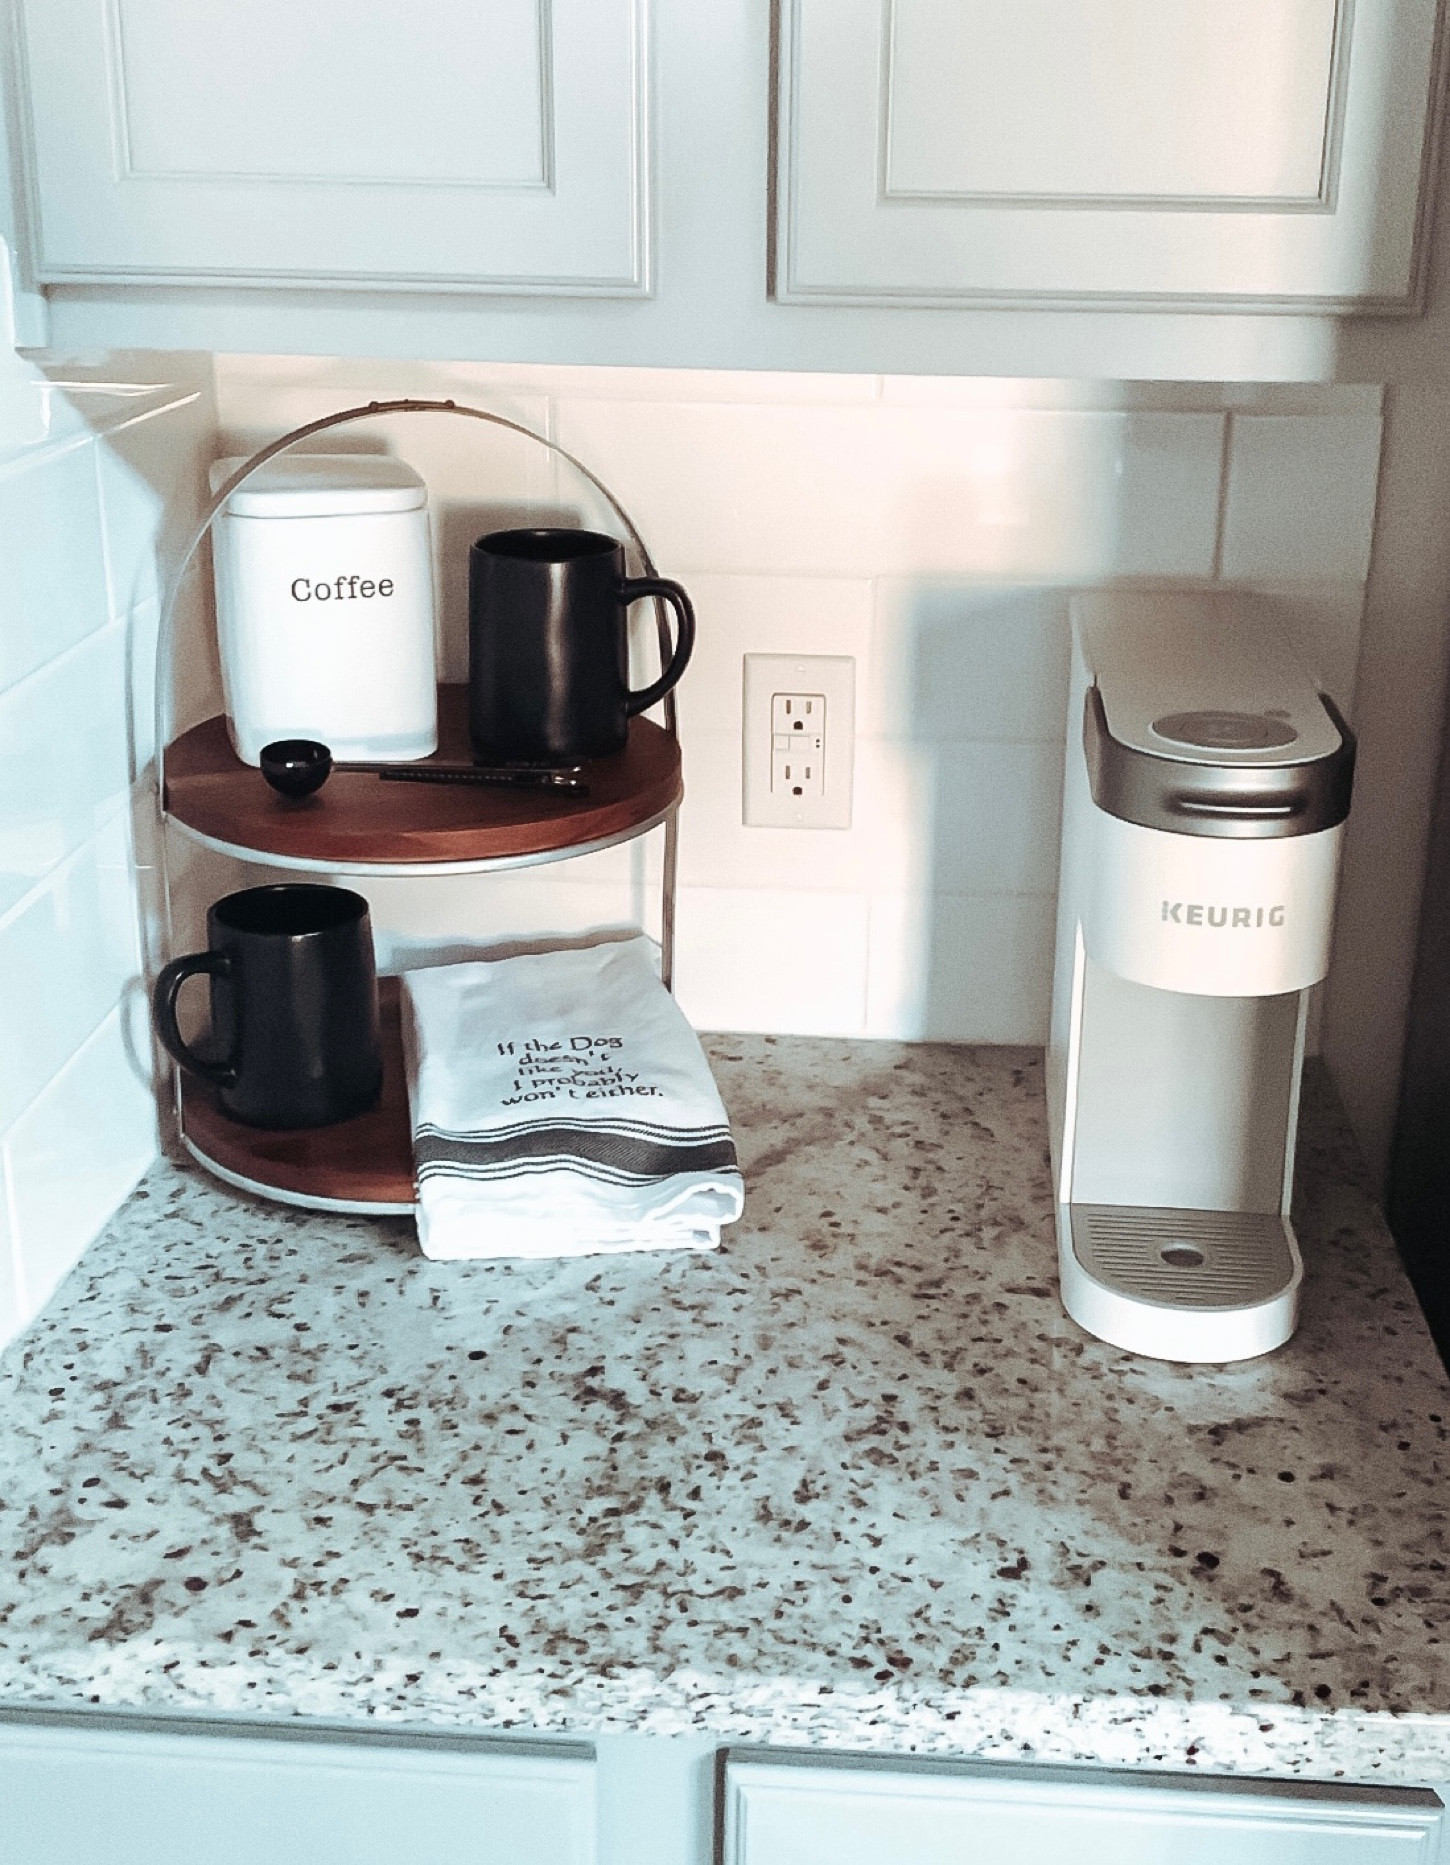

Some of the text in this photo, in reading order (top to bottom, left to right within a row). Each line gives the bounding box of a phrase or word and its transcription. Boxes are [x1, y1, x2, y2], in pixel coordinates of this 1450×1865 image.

[291, 575, 394, 602] Coffee
[1161, 900, 1285, 928] KEURIG
[497, 1036, 623, 1056] If the Dog
[518, 1065, 562, 1076] like
[513, 1072, 639, 1091] I probably
[501, 1084, 664, 1106] won't either.
